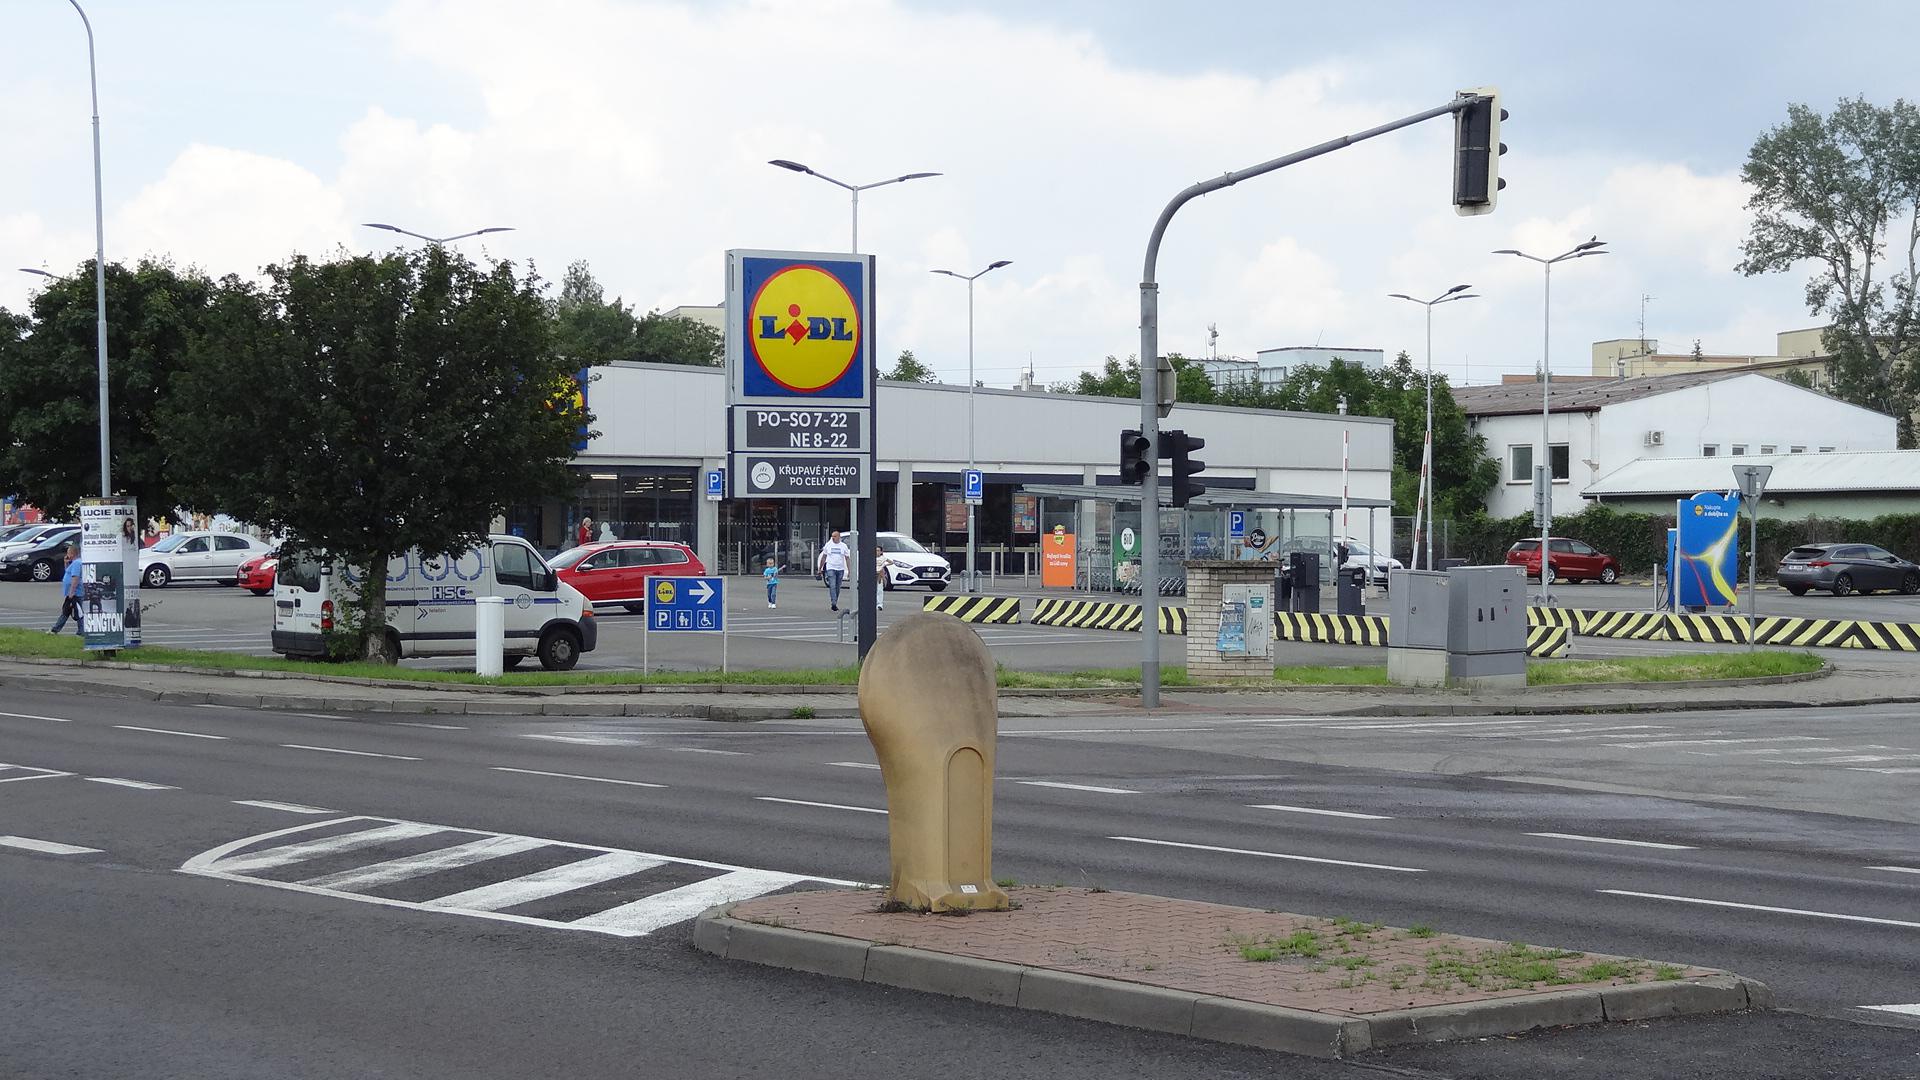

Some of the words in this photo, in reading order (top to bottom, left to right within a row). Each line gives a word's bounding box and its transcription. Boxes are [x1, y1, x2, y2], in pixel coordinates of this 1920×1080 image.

[790, 432, 811, 447] NE
[813, 433, 848, 448] 8-22
[779, 465, 821, 476] KŘUPAVÉ
[823, 465, 857, 476] PEČIVO
[710, 474, 719, 488] P
[790, 477, 803, 486] PO
[805, 475, 826, 486] CELÝ
[828, 477, 847, 486] DEN
[969, 474, 979, 490] P
[1232, 514, 1241, 529] P
[658, 612, 668, 626] P
